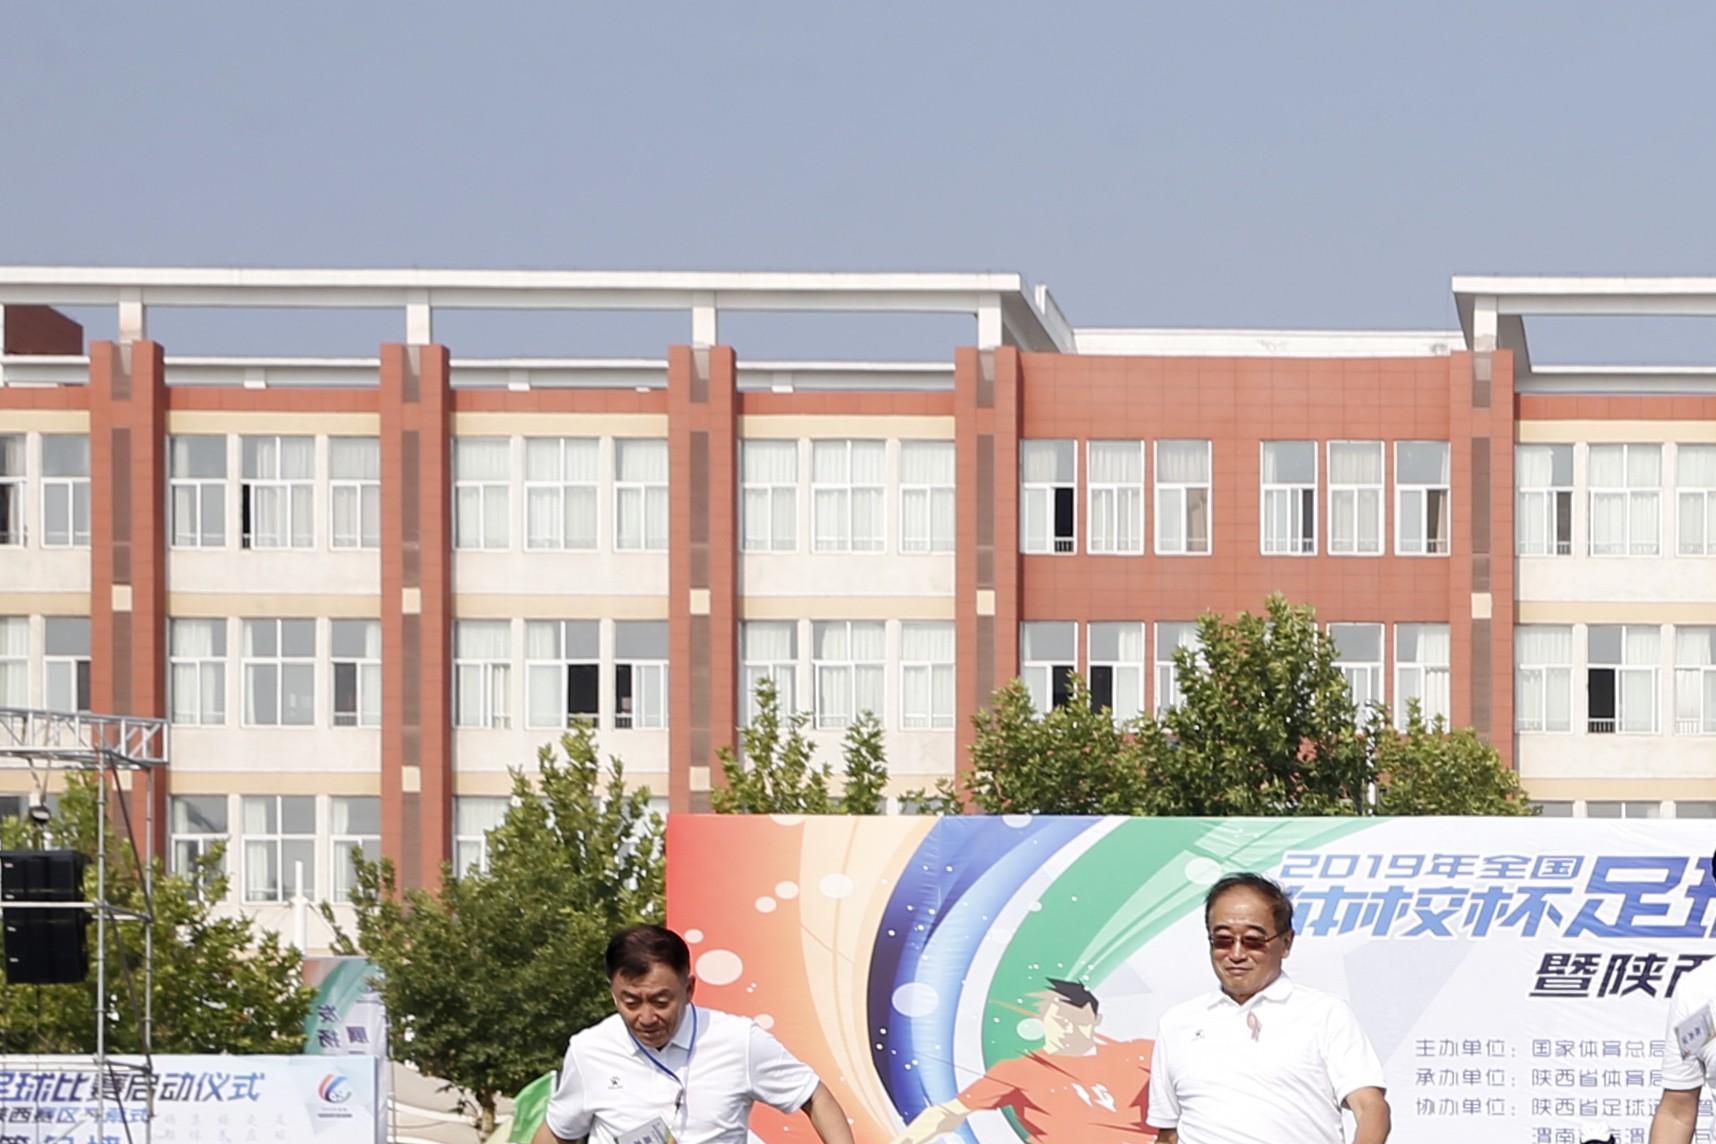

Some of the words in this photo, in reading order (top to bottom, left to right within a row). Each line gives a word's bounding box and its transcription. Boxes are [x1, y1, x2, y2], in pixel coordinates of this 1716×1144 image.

[1279, 854, 1582, 880] 2019年全国
[1532, 1039, 1666, 1058] 国家体育总局
